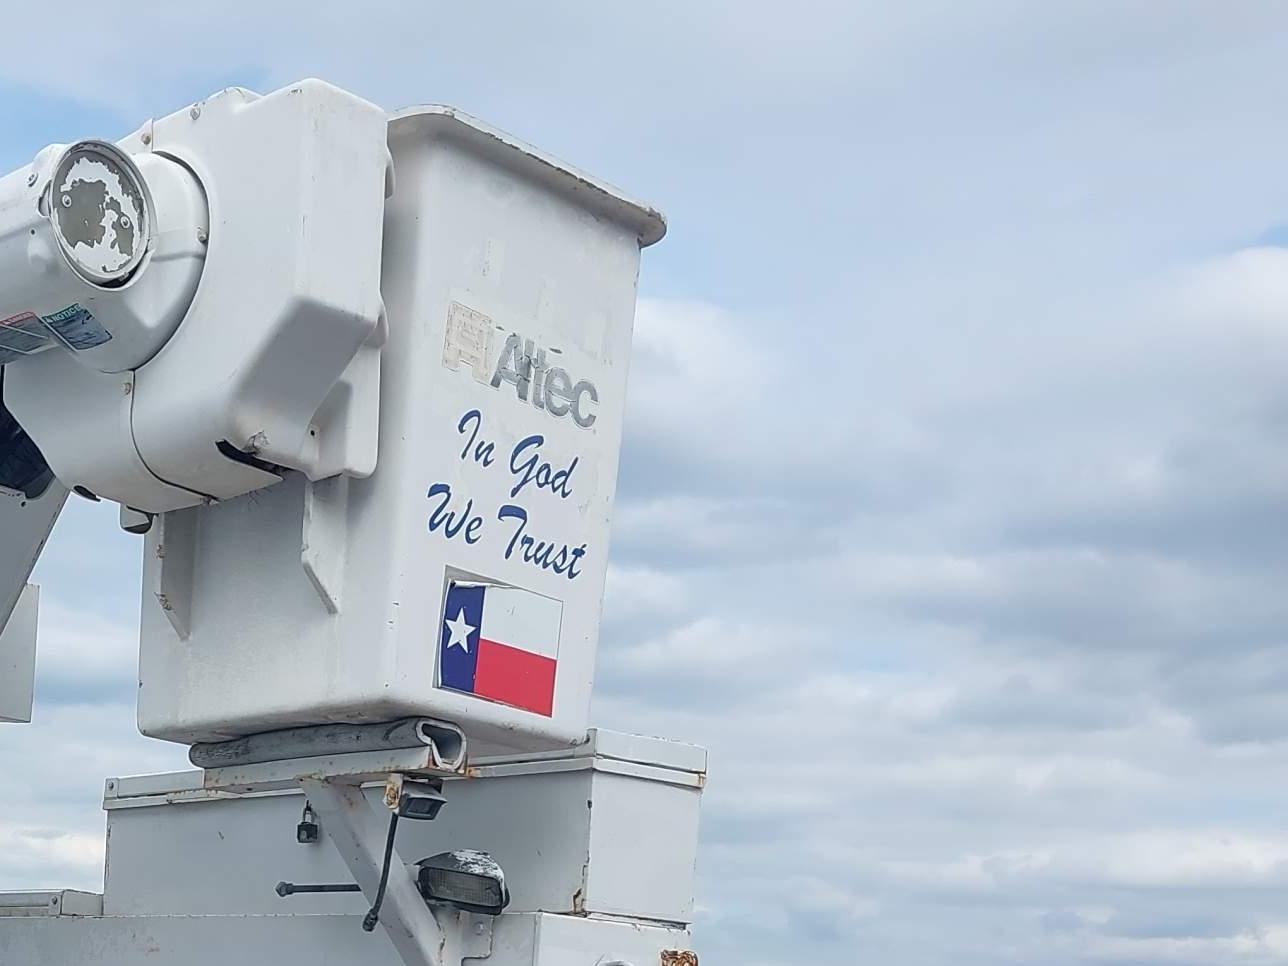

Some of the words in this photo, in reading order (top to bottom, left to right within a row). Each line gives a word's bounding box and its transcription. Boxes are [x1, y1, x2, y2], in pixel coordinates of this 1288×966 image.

[52, 304, 82, 321] NOTICE
[490, 333, 599, 428] Altec
[457, 409, 496, 467] In
[509, 435, 579, 499] God
[427, 483, 482, 545] We
[497, 504, 586, 580] Trust
